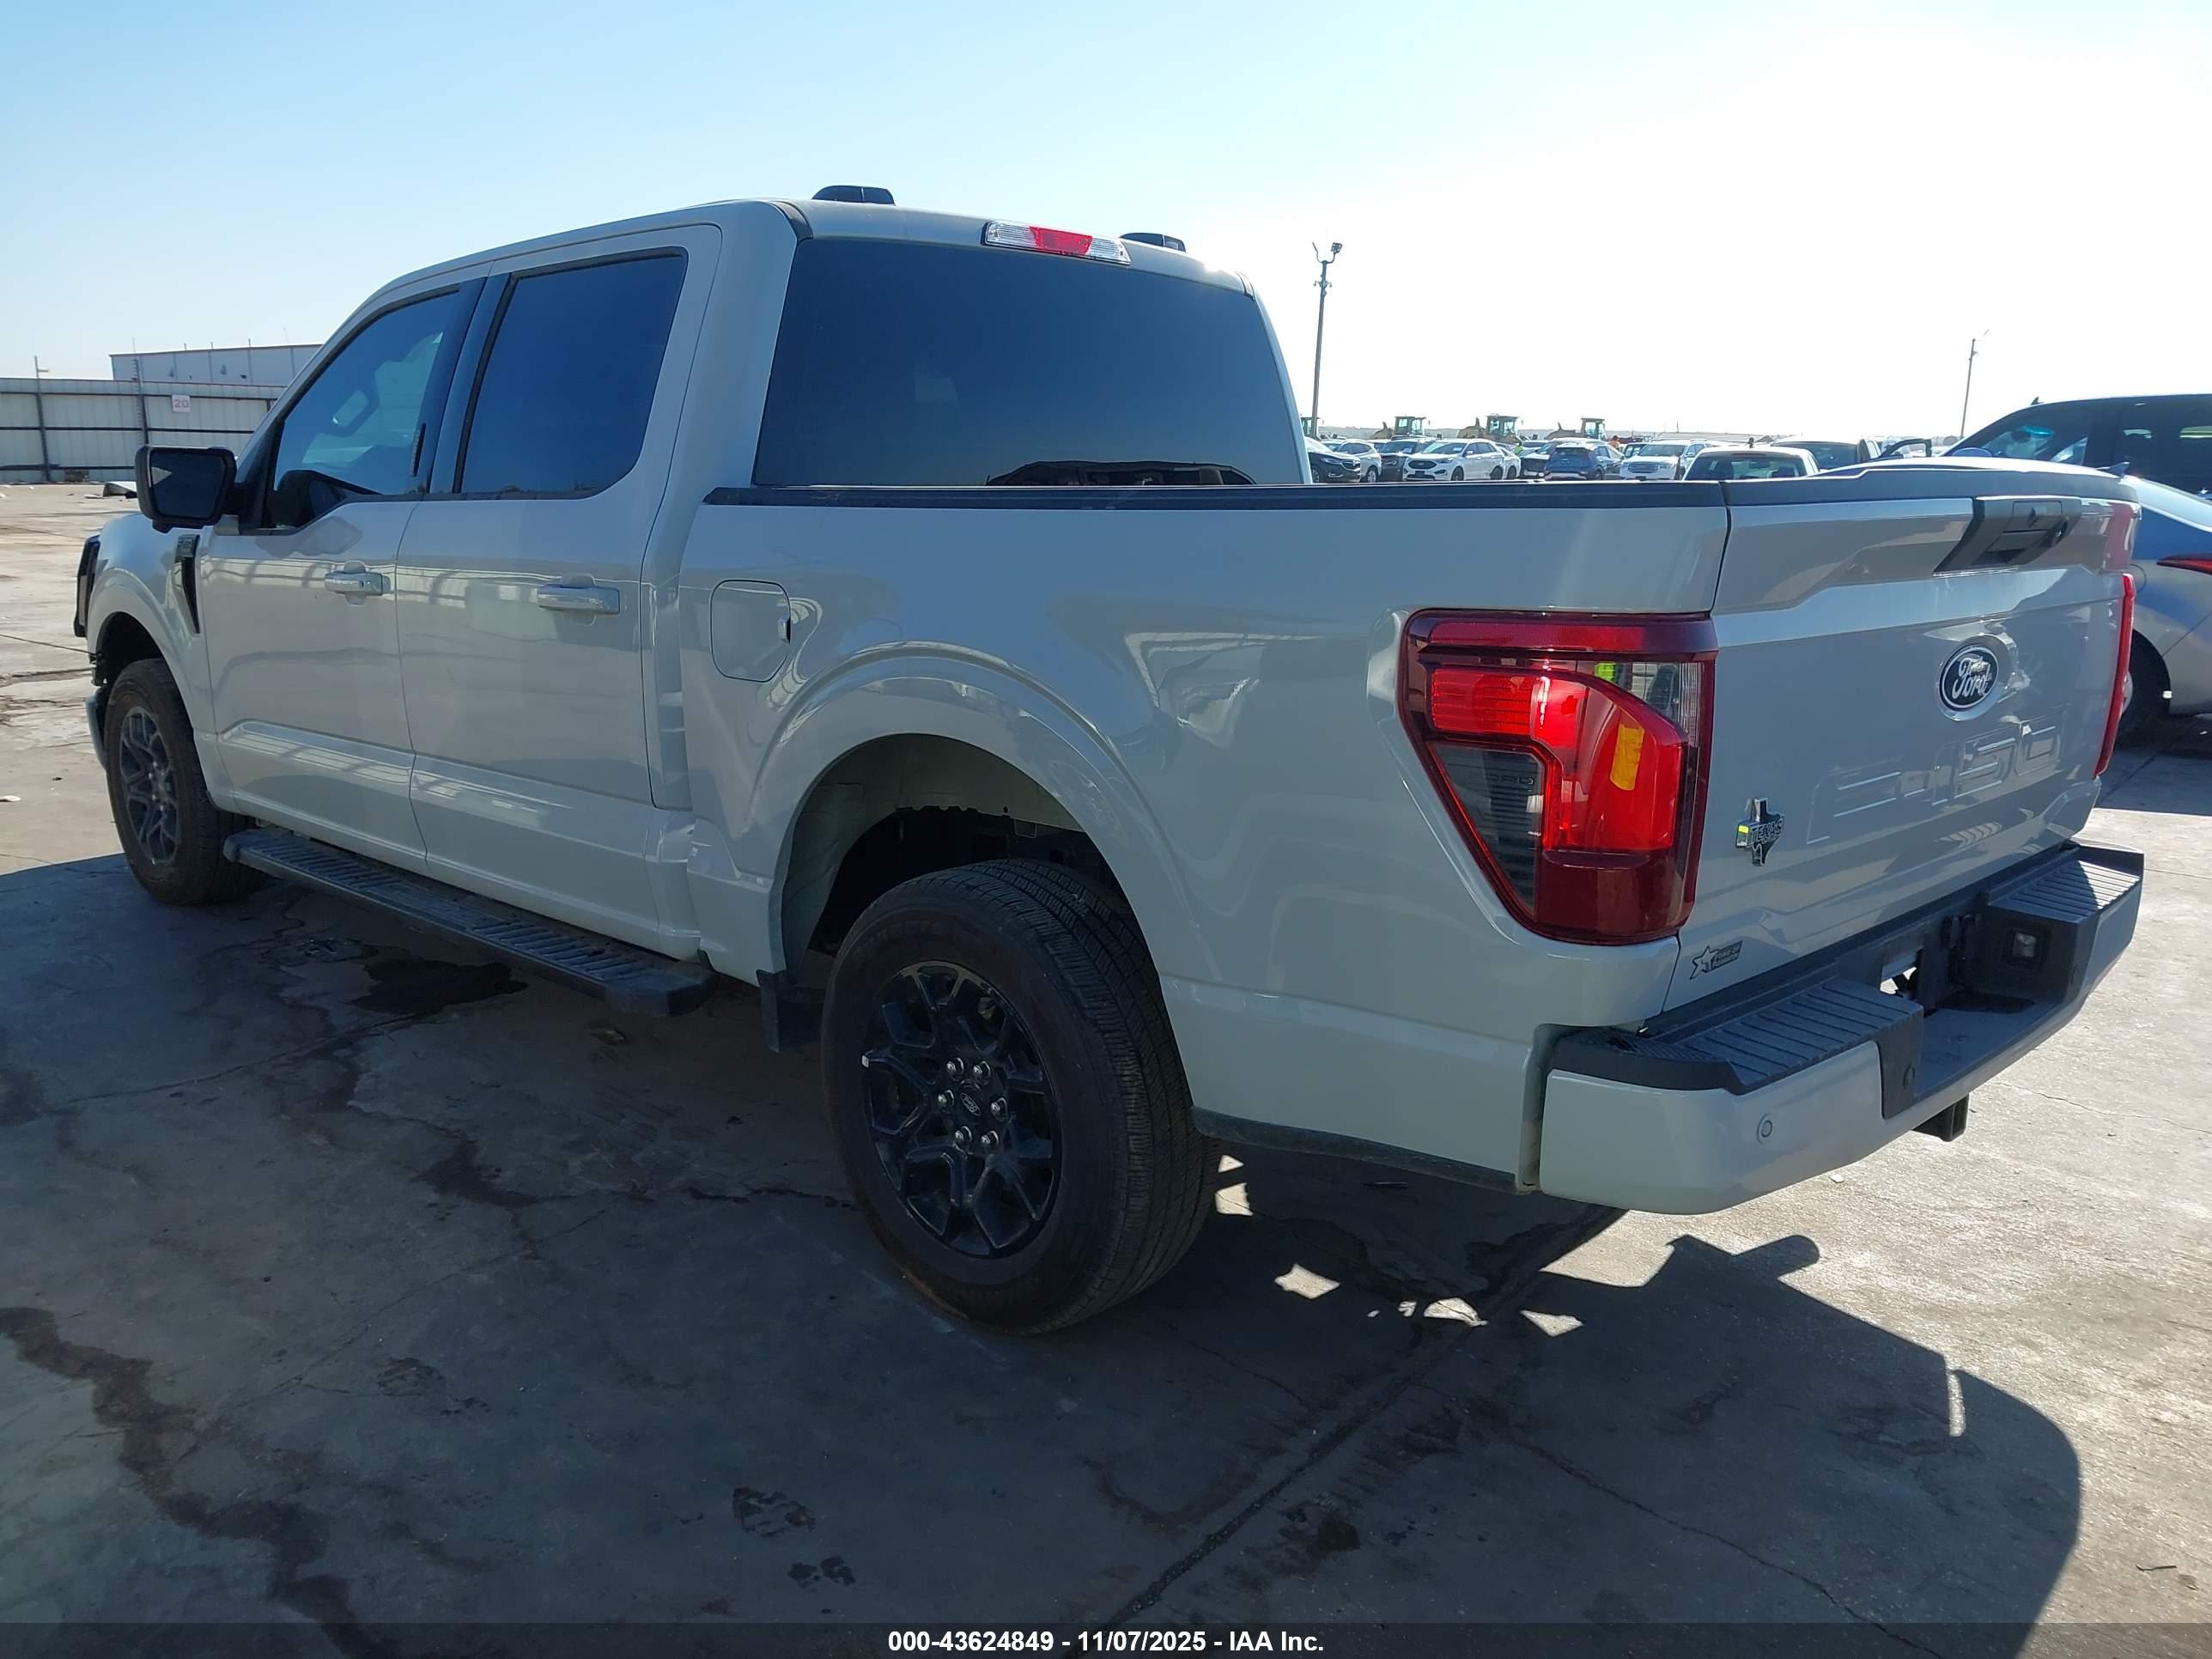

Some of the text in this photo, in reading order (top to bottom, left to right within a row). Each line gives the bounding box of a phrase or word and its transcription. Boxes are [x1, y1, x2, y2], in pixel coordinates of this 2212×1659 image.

[173, 398, 189, 409] 20
[1952, 656, 1990, 699] Ford
[1750, 817, 1784, 844] TEXAS
